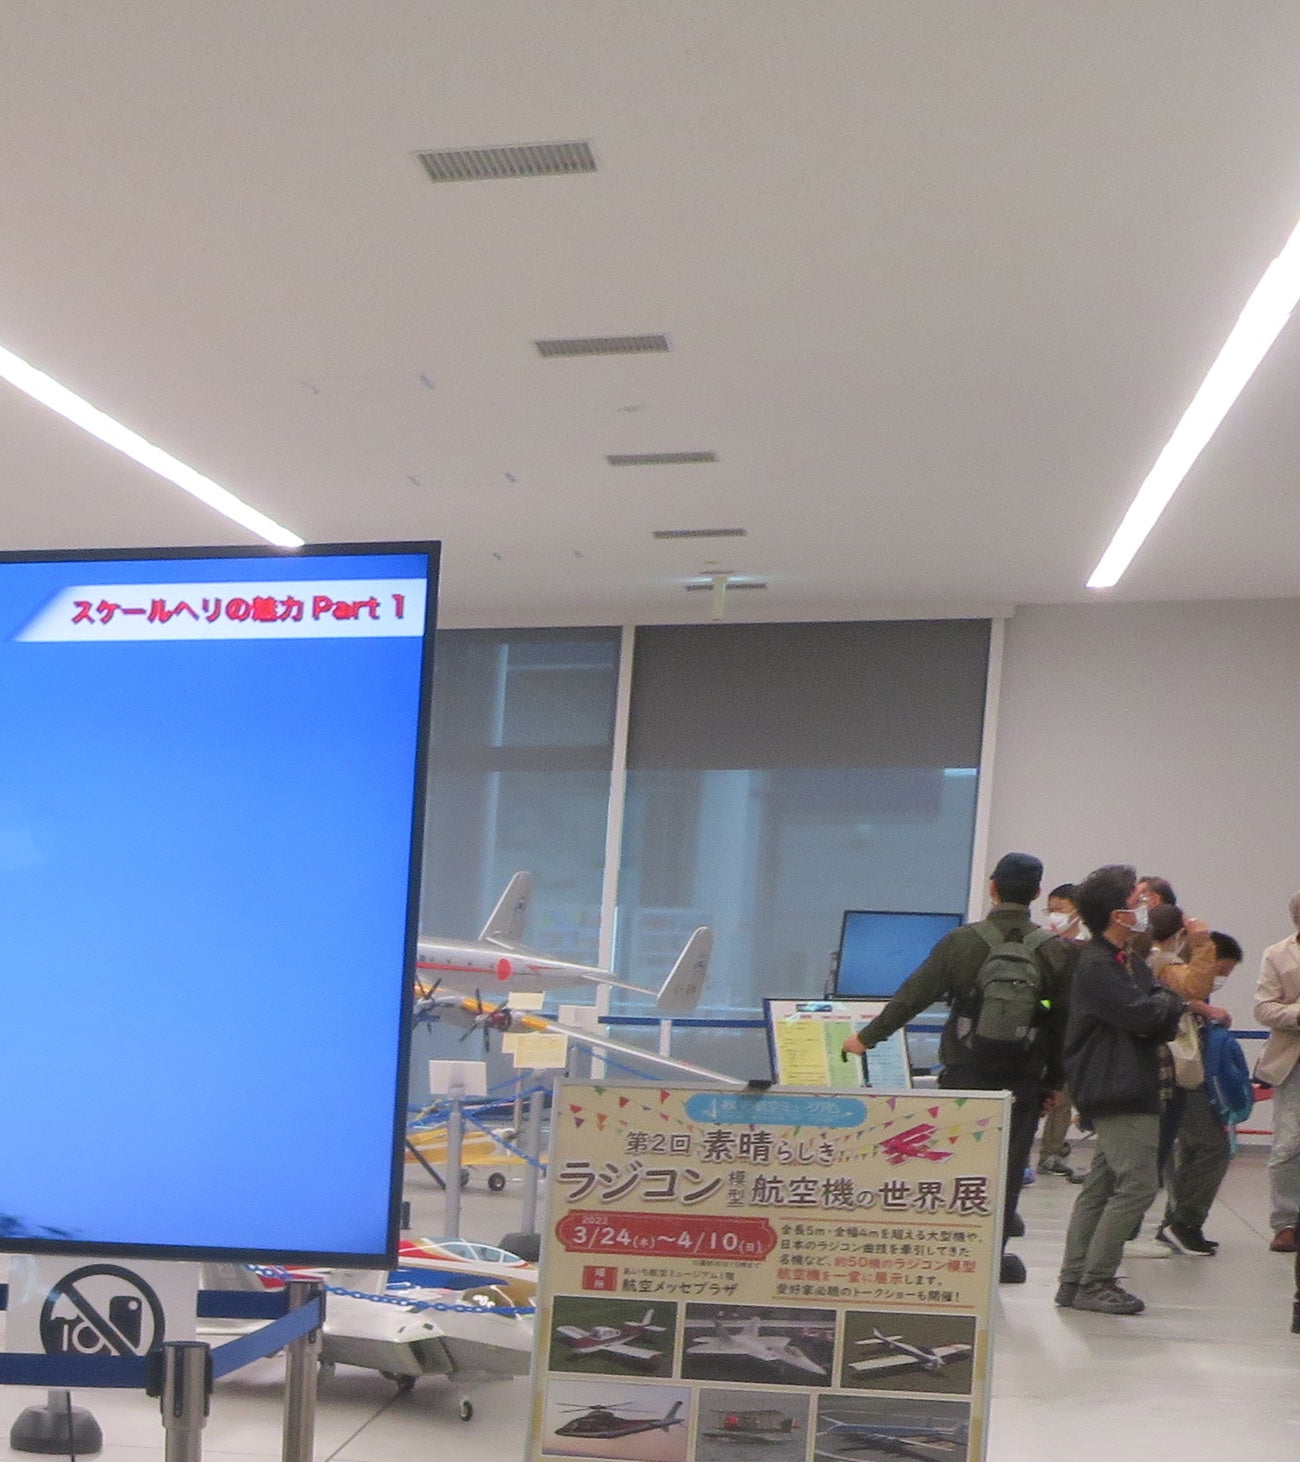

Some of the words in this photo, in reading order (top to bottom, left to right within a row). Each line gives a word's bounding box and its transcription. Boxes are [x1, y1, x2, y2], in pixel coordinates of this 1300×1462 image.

[72, 597, 305, 624] スケールヘリの魅力
[313, 594, 379, 620] Part
[393, 594, 405, 619] 1
[626, 1130, 692, 1154] 第2回
[703, 1128, 835, 1165] 素晴らしき
